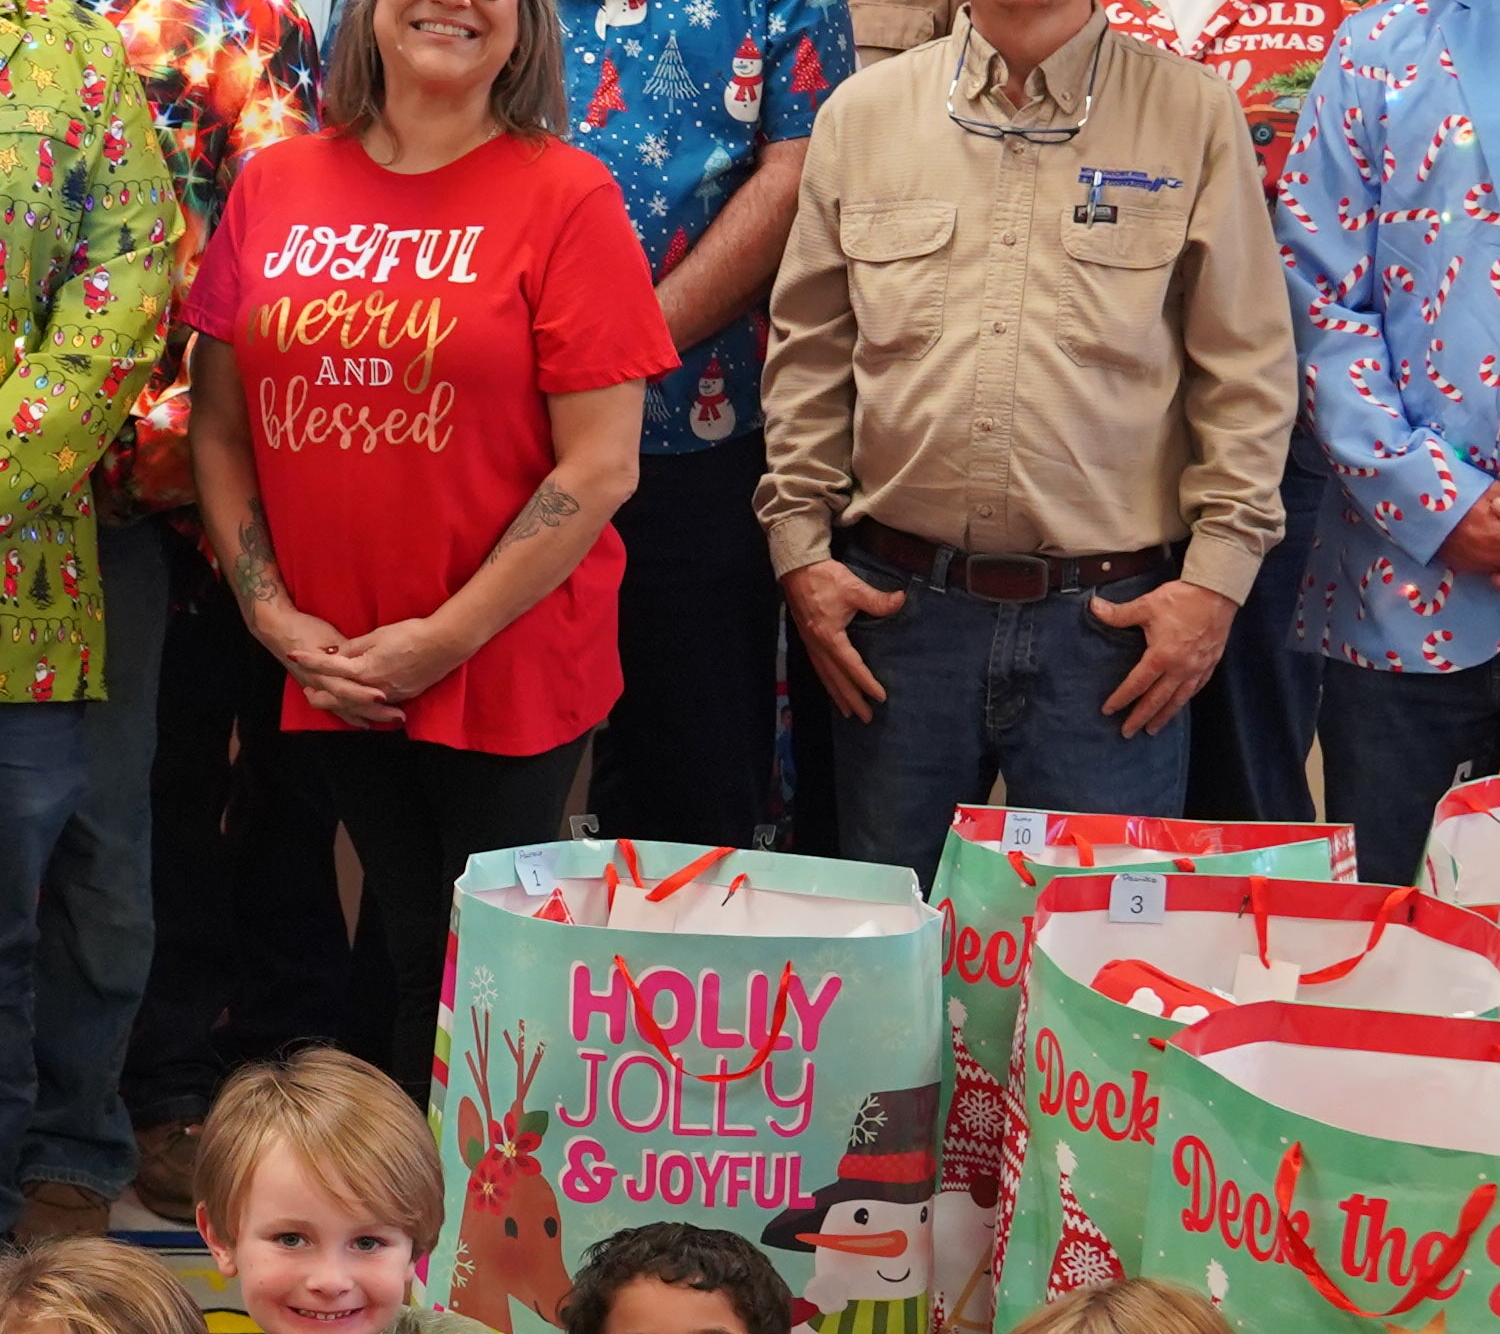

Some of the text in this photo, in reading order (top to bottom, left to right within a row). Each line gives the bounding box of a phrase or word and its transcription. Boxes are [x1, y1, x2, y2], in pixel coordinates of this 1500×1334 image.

[1239, 2, 1325, 27] OLD
[263, 223, 484, 284] JOYFUL
[248, 289, 458, 395] merry
[314, 356, 394, 387] AND
[260, 375, 456, 454] blessed
[1013, 828, 1031, 845] 10
[1130, 895, 1143, 913] 3
[569, 961, 843, 1051] HOLLY
[555, 1049, 815, 1137] JOLLY
[1035, 1026, 1160, 1146] Deck
[558, 1136, 816, 1210] & JOYFUL
[1171, 1136, 1318, 1266] Deck
[1339, 1194, 1482, 1300] the
